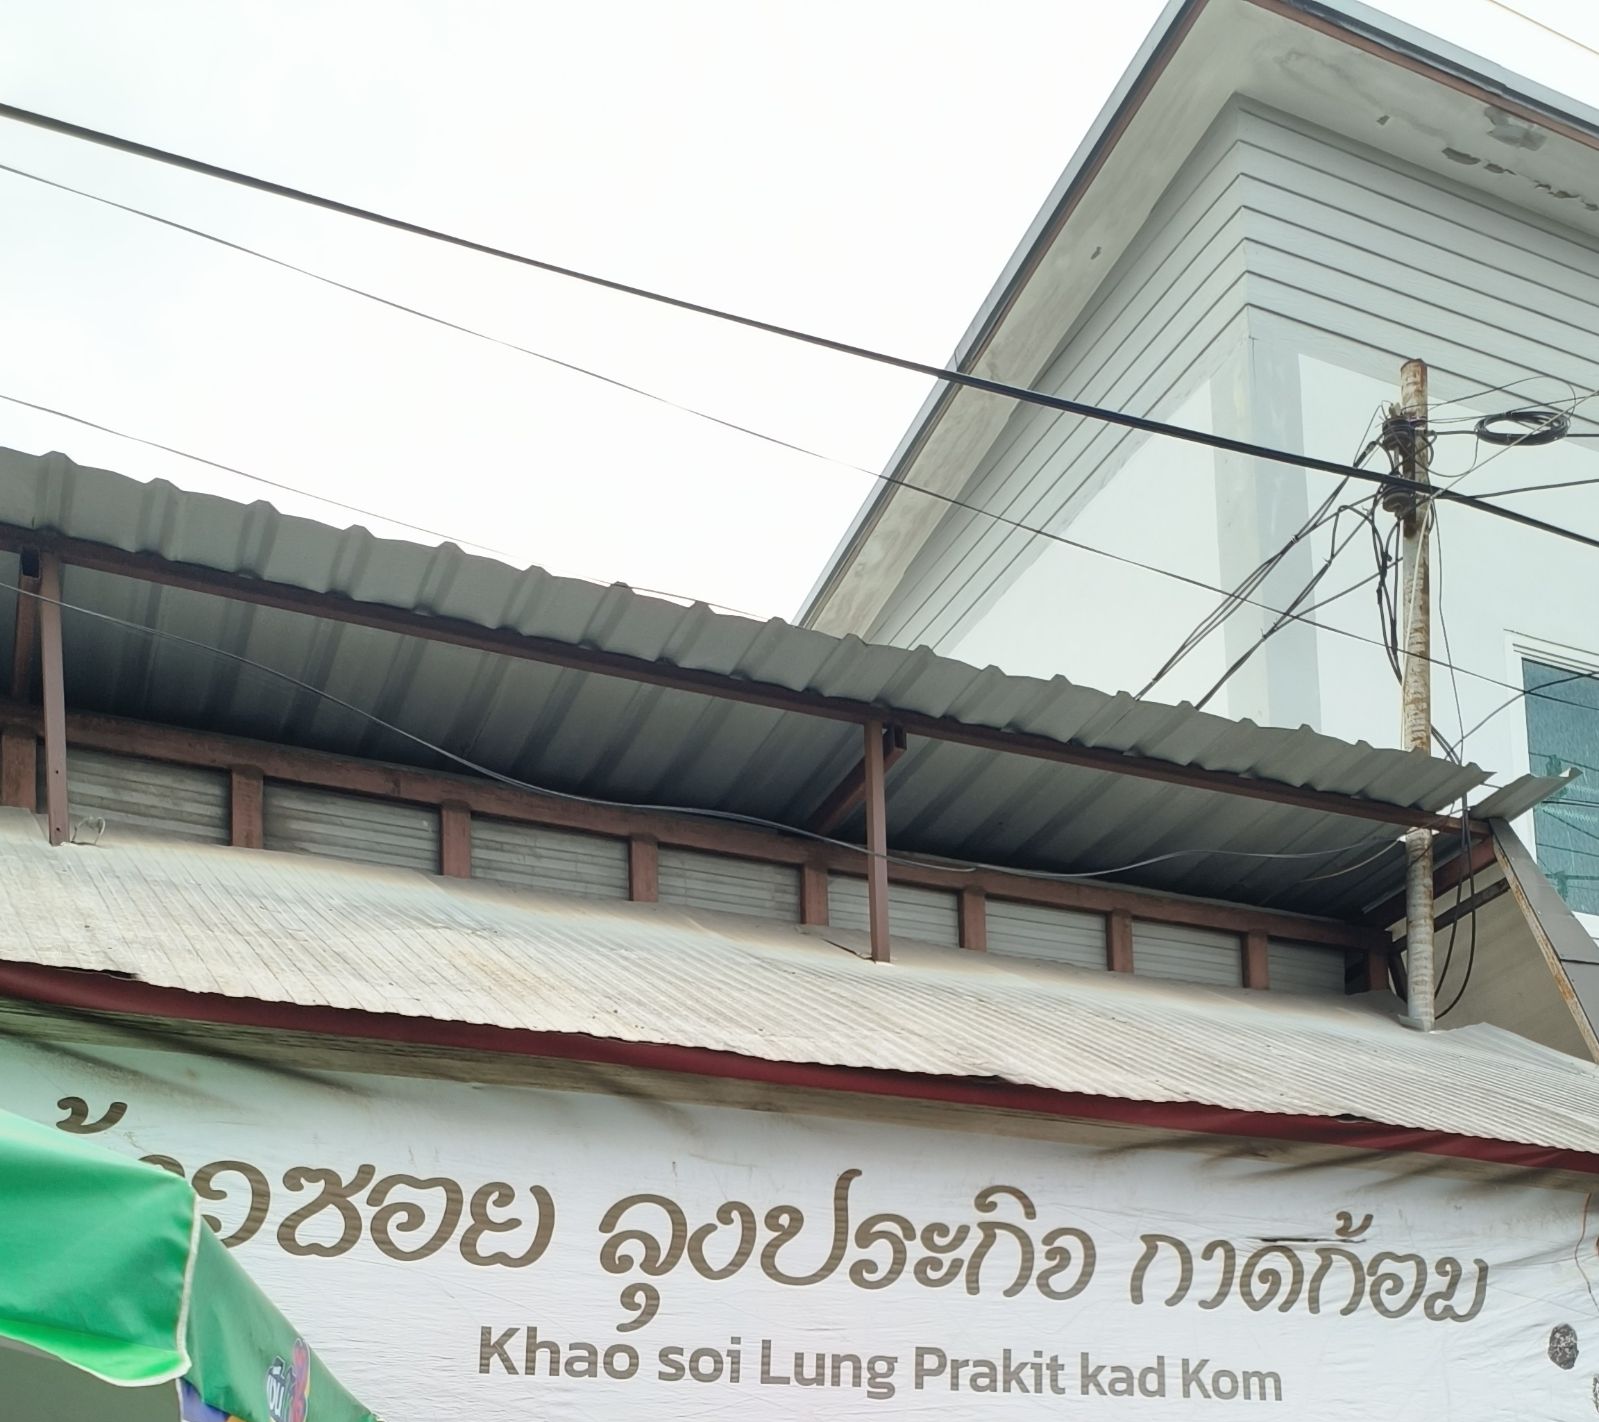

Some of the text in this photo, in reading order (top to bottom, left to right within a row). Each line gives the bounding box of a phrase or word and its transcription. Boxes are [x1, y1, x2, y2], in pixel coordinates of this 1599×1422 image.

[56, 1095, 1490, 1333] ้วซอย ลุงประกิจ กาดก้อม
[479, 1326, 1283, 1402] Khao soi Lung Prakit kad Kom
